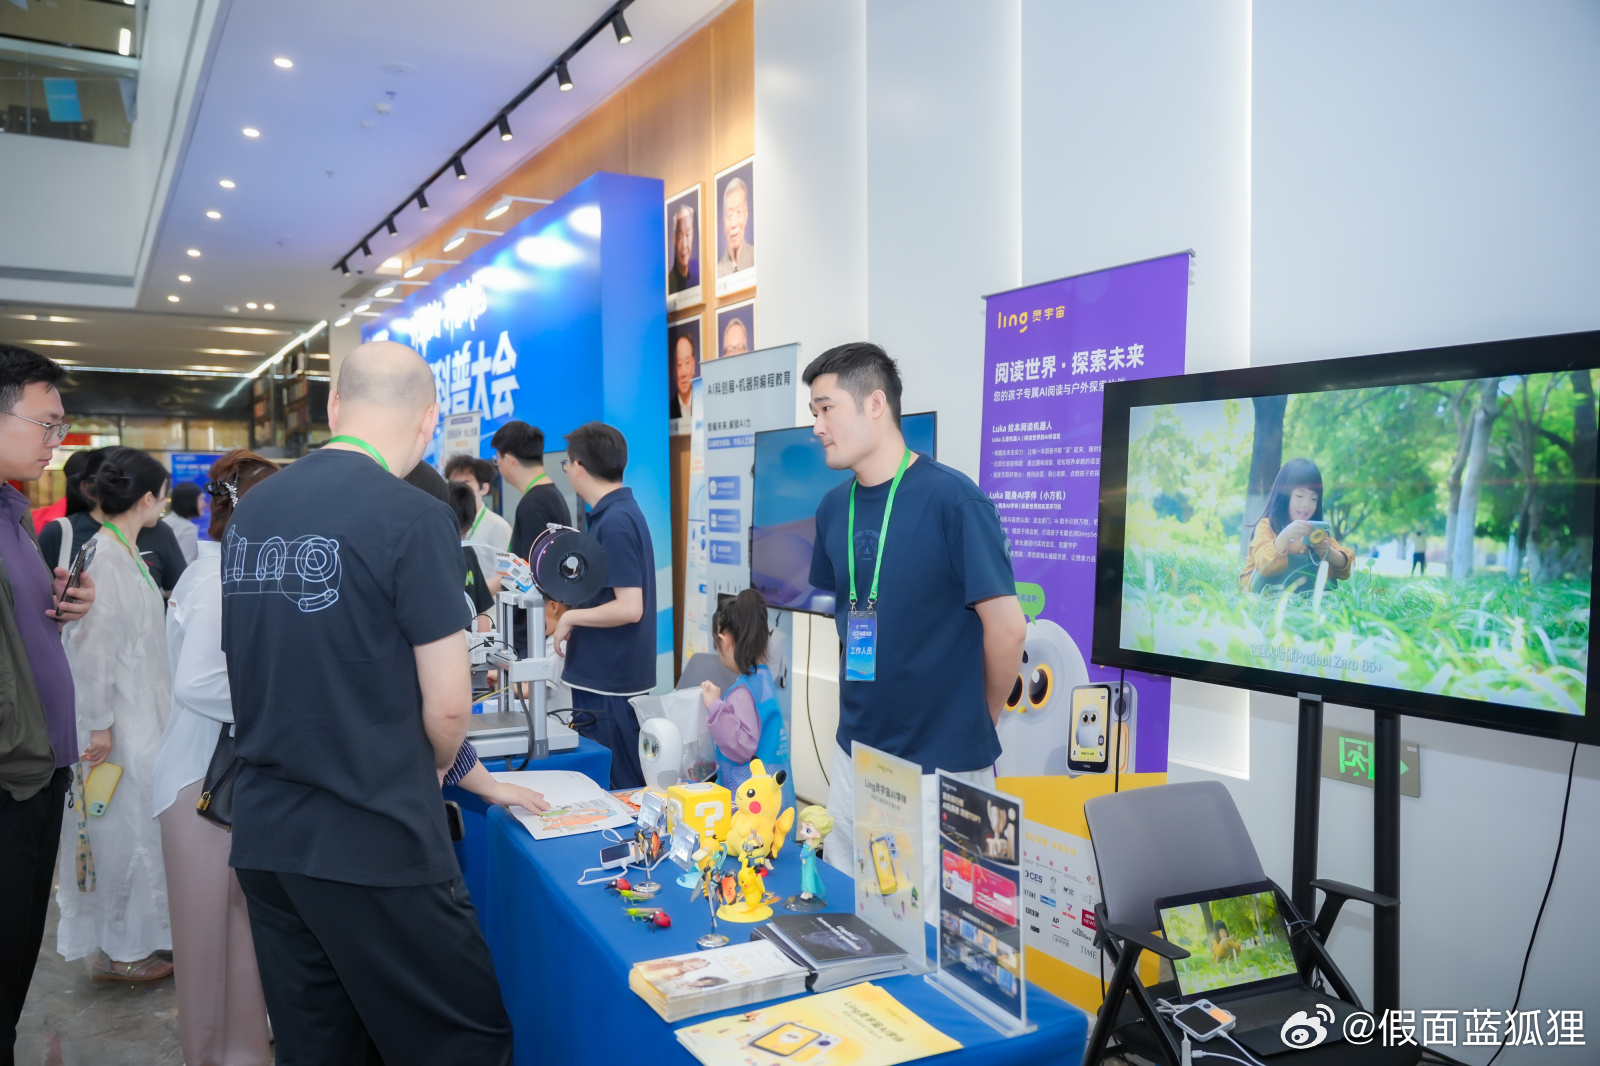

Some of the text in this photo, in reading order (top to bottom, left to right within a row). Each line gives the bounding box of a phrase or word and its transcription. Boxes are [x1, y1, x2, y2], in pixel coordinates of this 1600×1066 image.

[993, 378, 1126, 402] 您的孩子专属AI阅读与户外探索
[992, 425, 1006, 433] Luka
[989, 491, 1003, 499] Luka
[850, 646, 873, 655] 工作人员
[1334, 656, 1359, 671] Zero
[1361, 659, 1383, 673] 65+
[1029, 872, 1043, 884] CES
[1080, 944, 1098, 959] TIME
